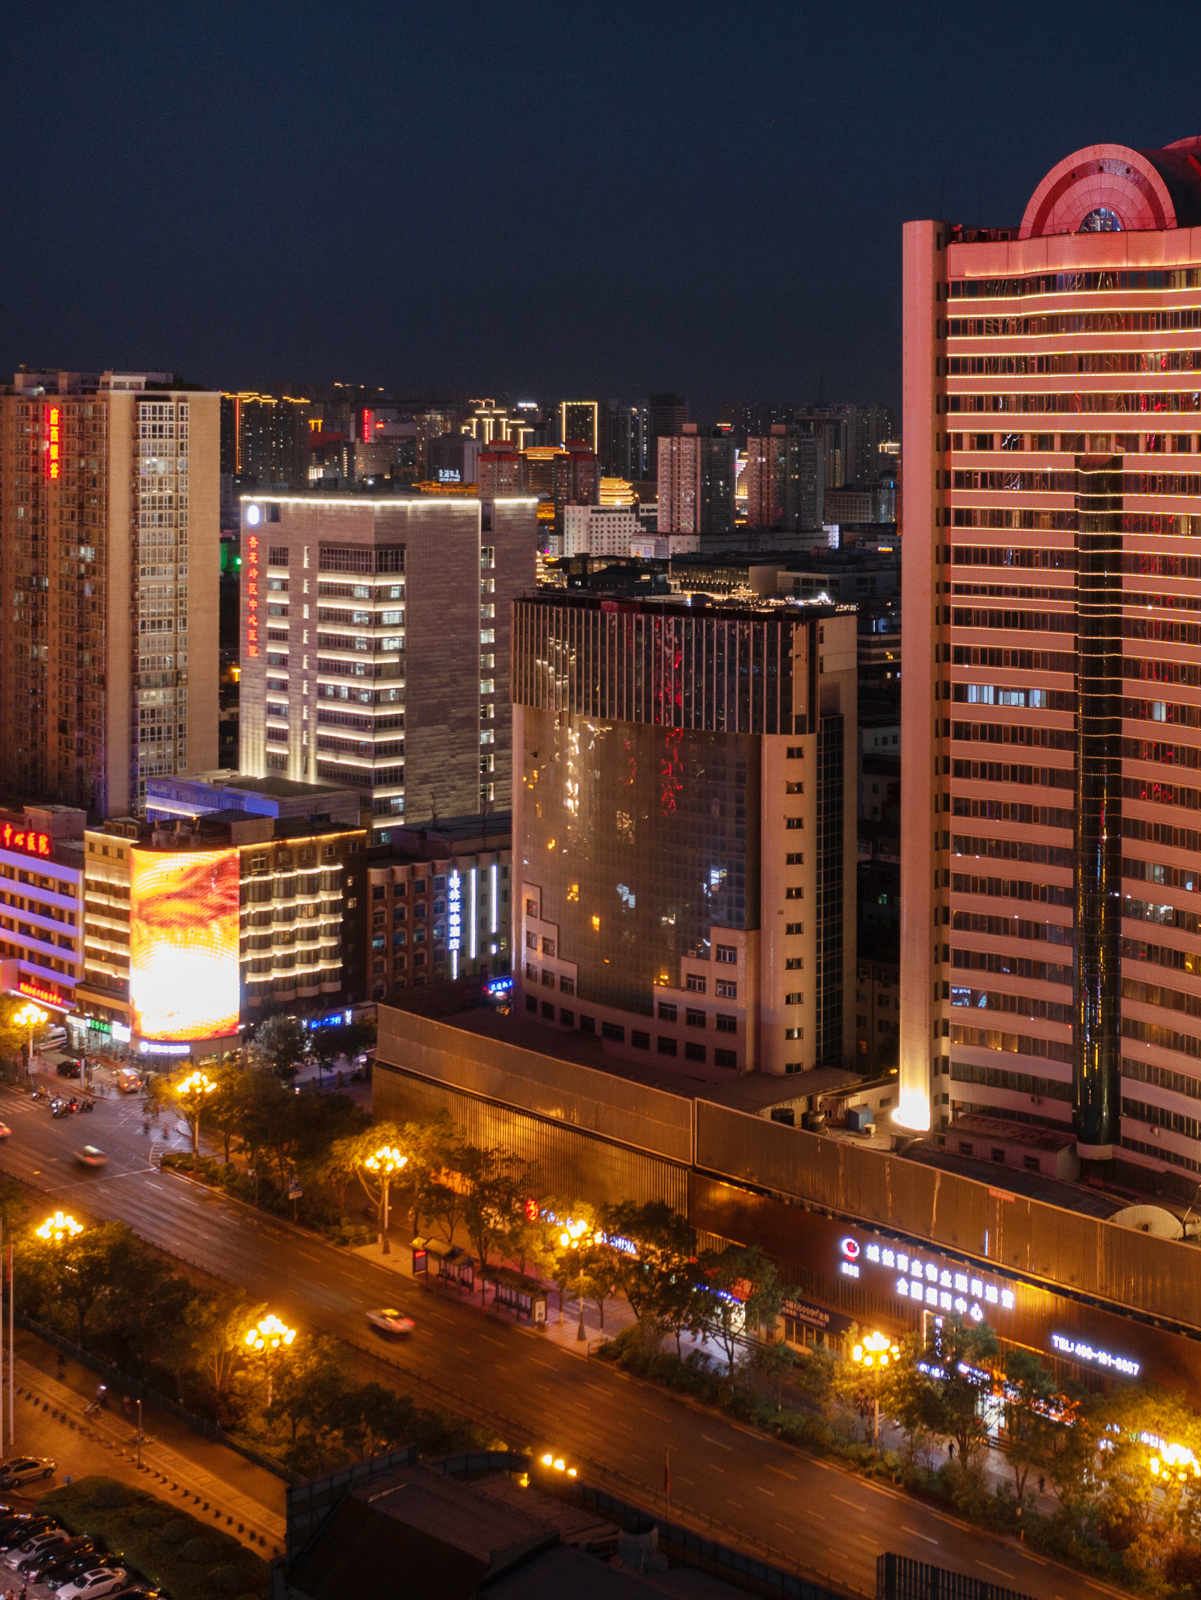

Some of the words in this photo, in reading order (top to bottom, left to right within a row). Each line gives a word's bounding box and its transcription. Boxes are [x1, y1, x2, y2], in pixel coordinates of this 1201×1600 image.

[247, 535, 259, 658] 杏花岭区中心医院
